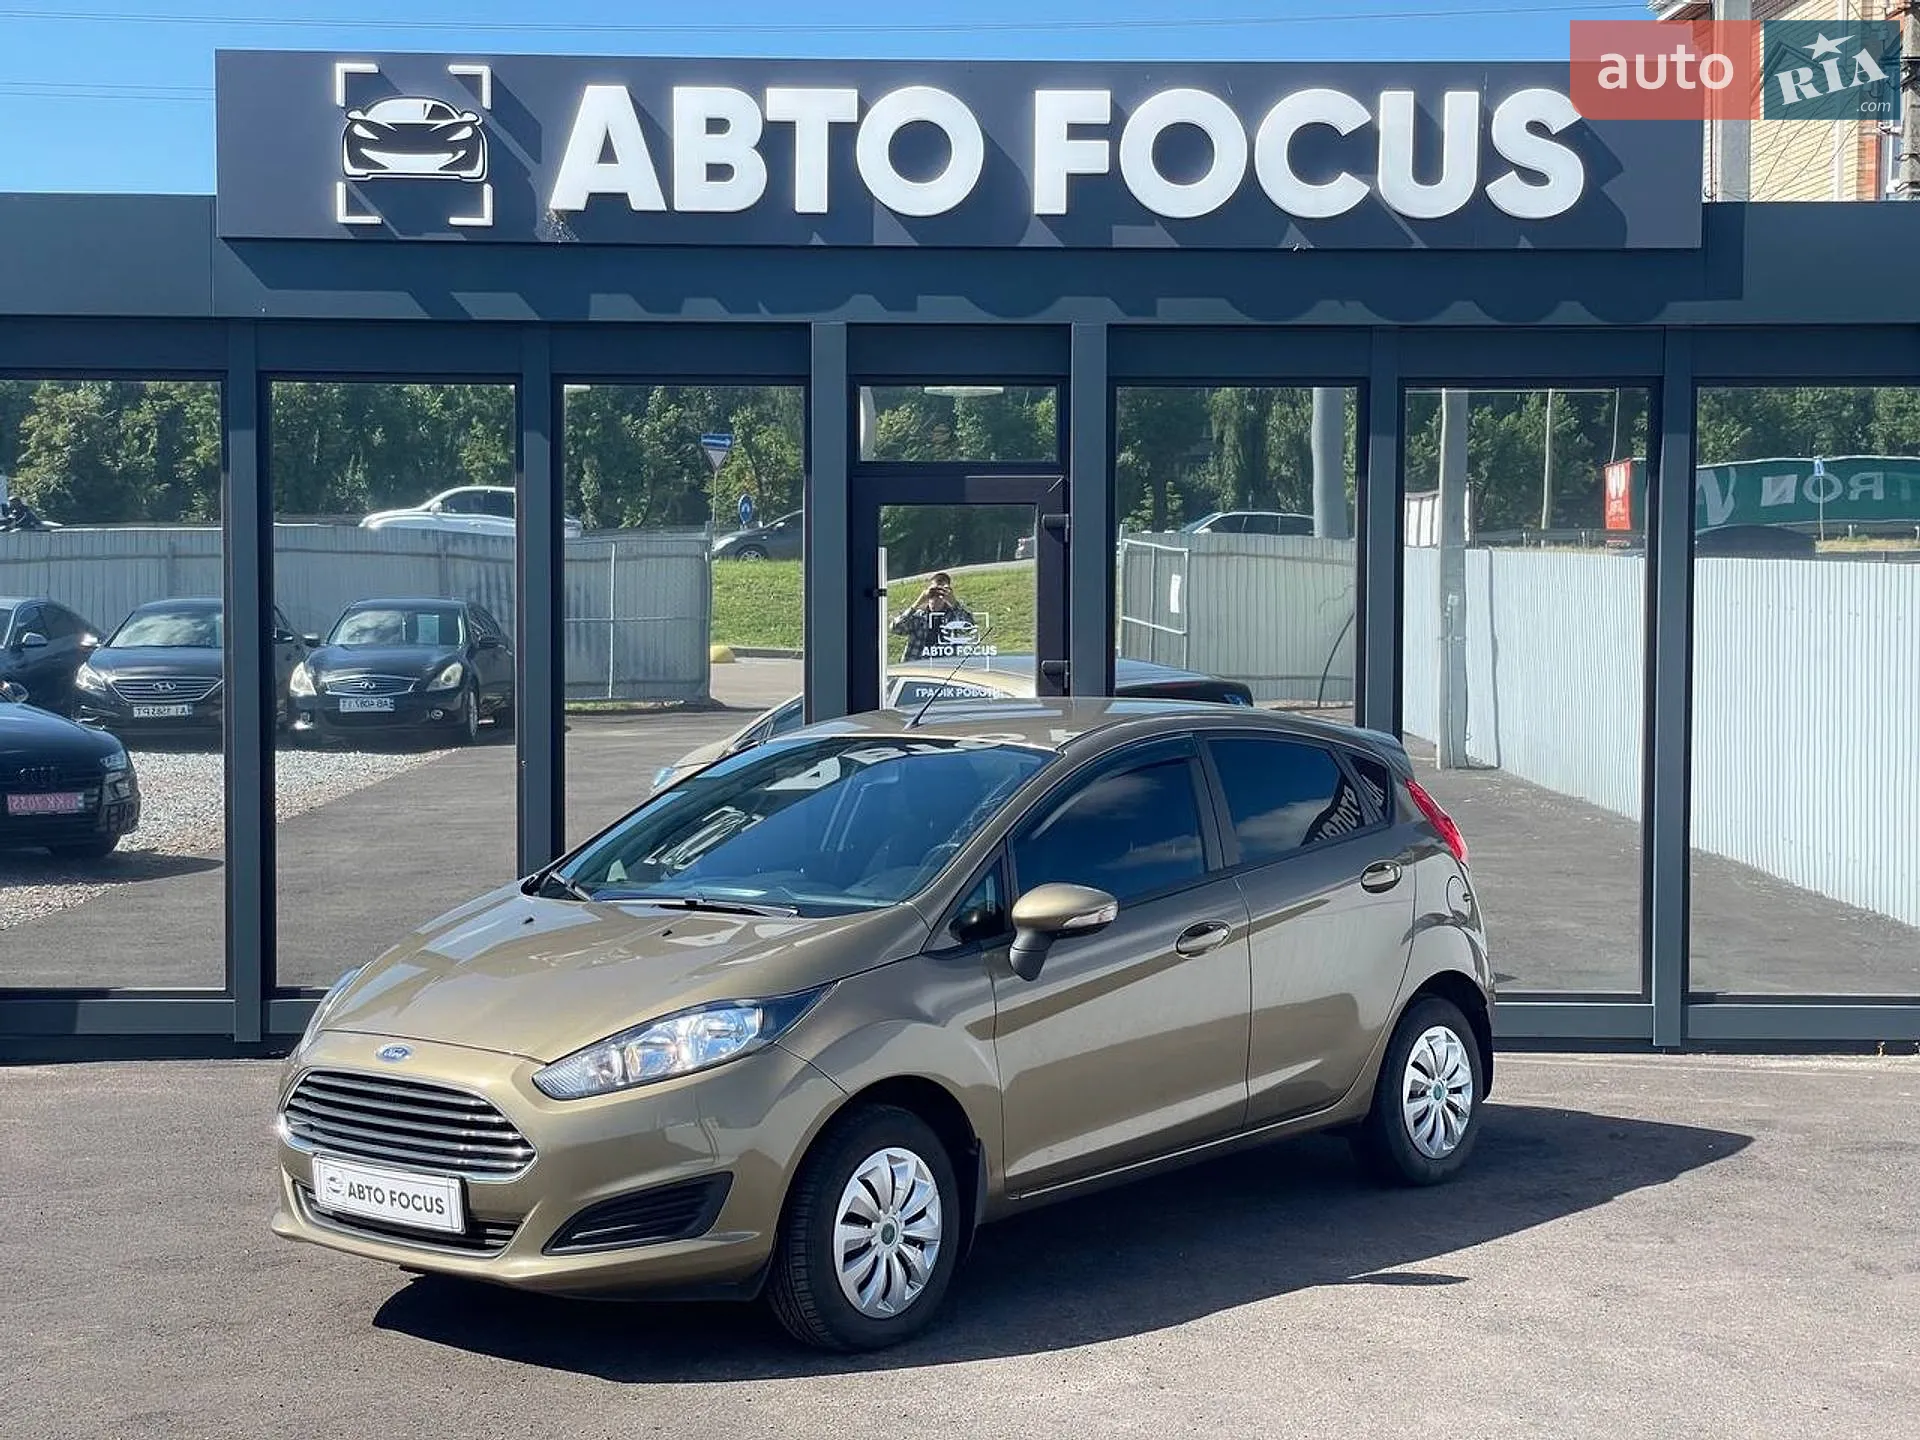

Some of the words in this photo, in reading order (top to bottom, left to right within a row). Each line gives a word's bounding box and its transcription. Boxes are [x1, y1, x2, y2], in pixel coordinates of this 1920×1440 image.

[548, 84, 985, 218] АВТО
[1033, 87, 1586, 220] FOCUS
[348, 1181, 385, 1205] АВТО
[389, 1189, 445, 1215] FOCUS
